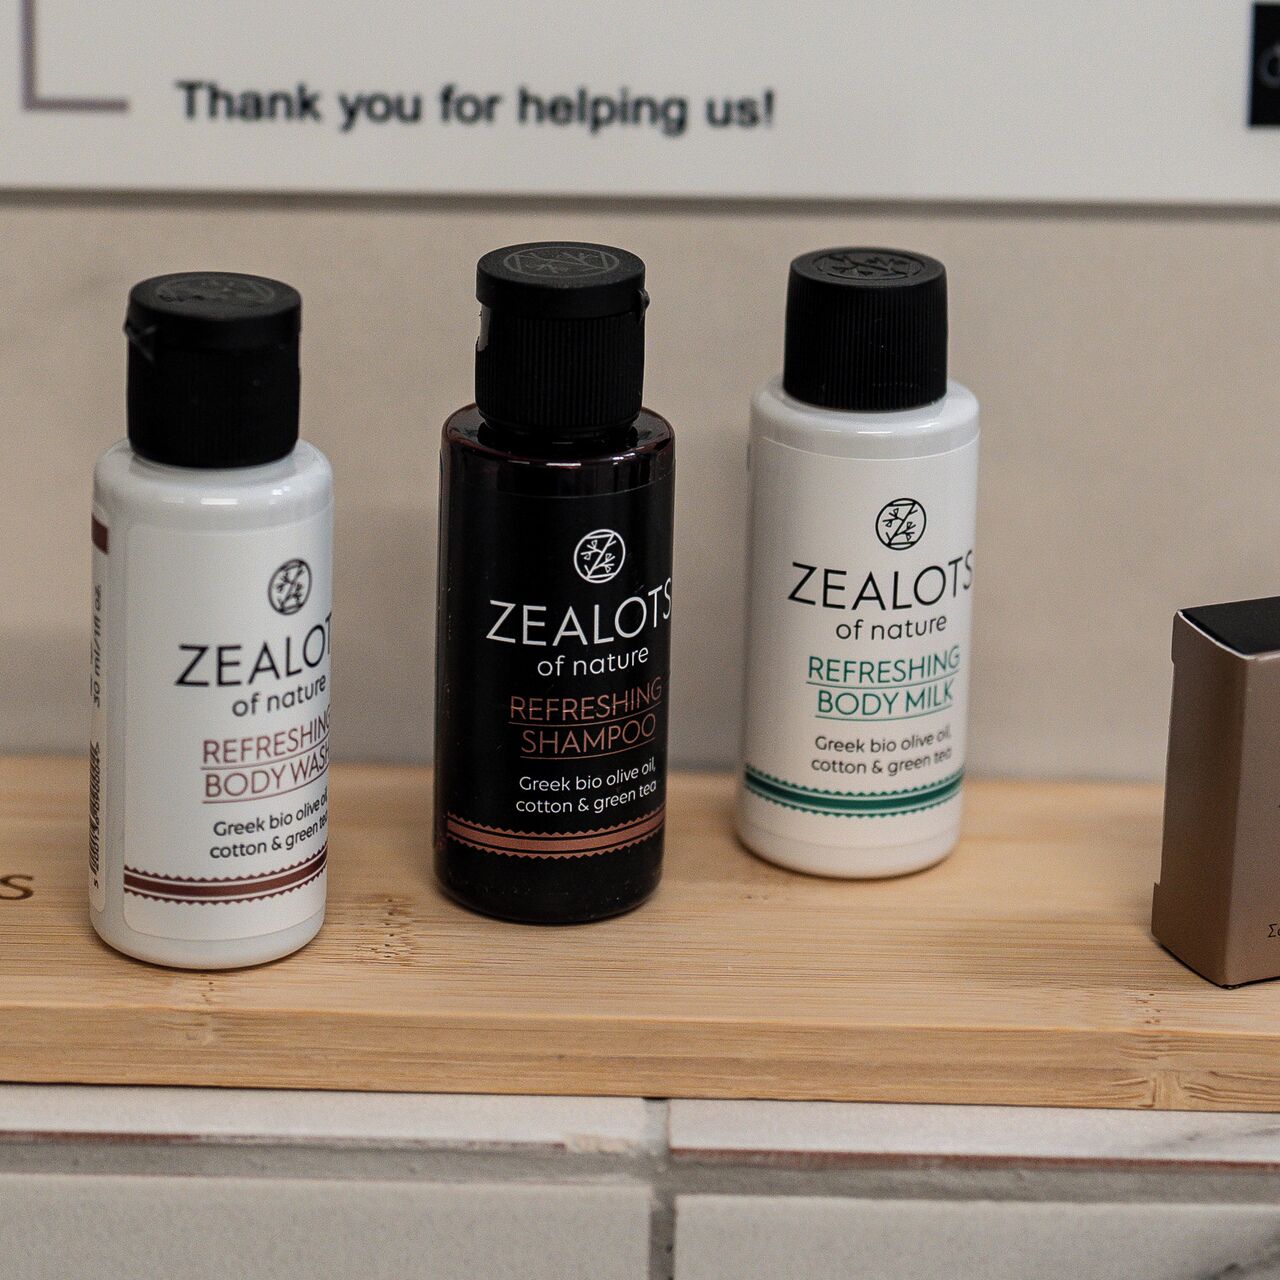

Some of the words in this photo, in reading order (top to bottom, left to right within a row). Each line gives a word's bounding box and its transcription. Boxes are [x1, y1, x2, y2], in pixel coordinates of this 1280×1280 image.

[176, 80, 321, 122] Thank
[338, 93, 422, 133] you
[439, 84, 502, 125] for
[518, 86, 688, 138] helping
[705, 89, 775, 129] us!
[788, 550, 972, 611] ZEALOTS
[486, 577, 671, 646] ZEALOTS
[836, 619, 863, 640] of
[871, 615, 947, 640] nature
[175, 612, 332, 686] ZEALOT
[537, 655, 565, 677] of
[573, 647, 648, 676] nature
[808, 645, 960, 683] REFRESHING
[232, 692, 259, 717] of
[267, 675, 326, 711] nature
[510, 676, 662, 721] REFRESHING
[817, 690, 899, 716] BODY
[905, 679, 954, 713] MILK
[521, 713, 656, 754] SHAMPOO
[815, 736, 865, 752] Greek
[870, 738, 896, 753] bio
[901, 734, 934, 751] olive
[205, 765, 286, 797] BODY
[519, 776, 571, 792] Greek
[575, 775, 602, 790] bio
[606, 767, 639, 786] olive
[811, 759, 866, 774] cotton
[872, 760, 883, 774] &
[888, 755, 931, 776] green
[516, 799, 573, 813] cotton
[578, 798, 589, 812] &
[594, 789, 636, 814] green
[639, 779, 657, 798] tea
[213, 817, 265, 836] Greek
[270, 814, 293, 829] bio
[295, 799, 319, 820] olive
[210, 841, 267, 859] cotton
[272, 836, 282, 851] &
[285, 823, 318, 851] green
